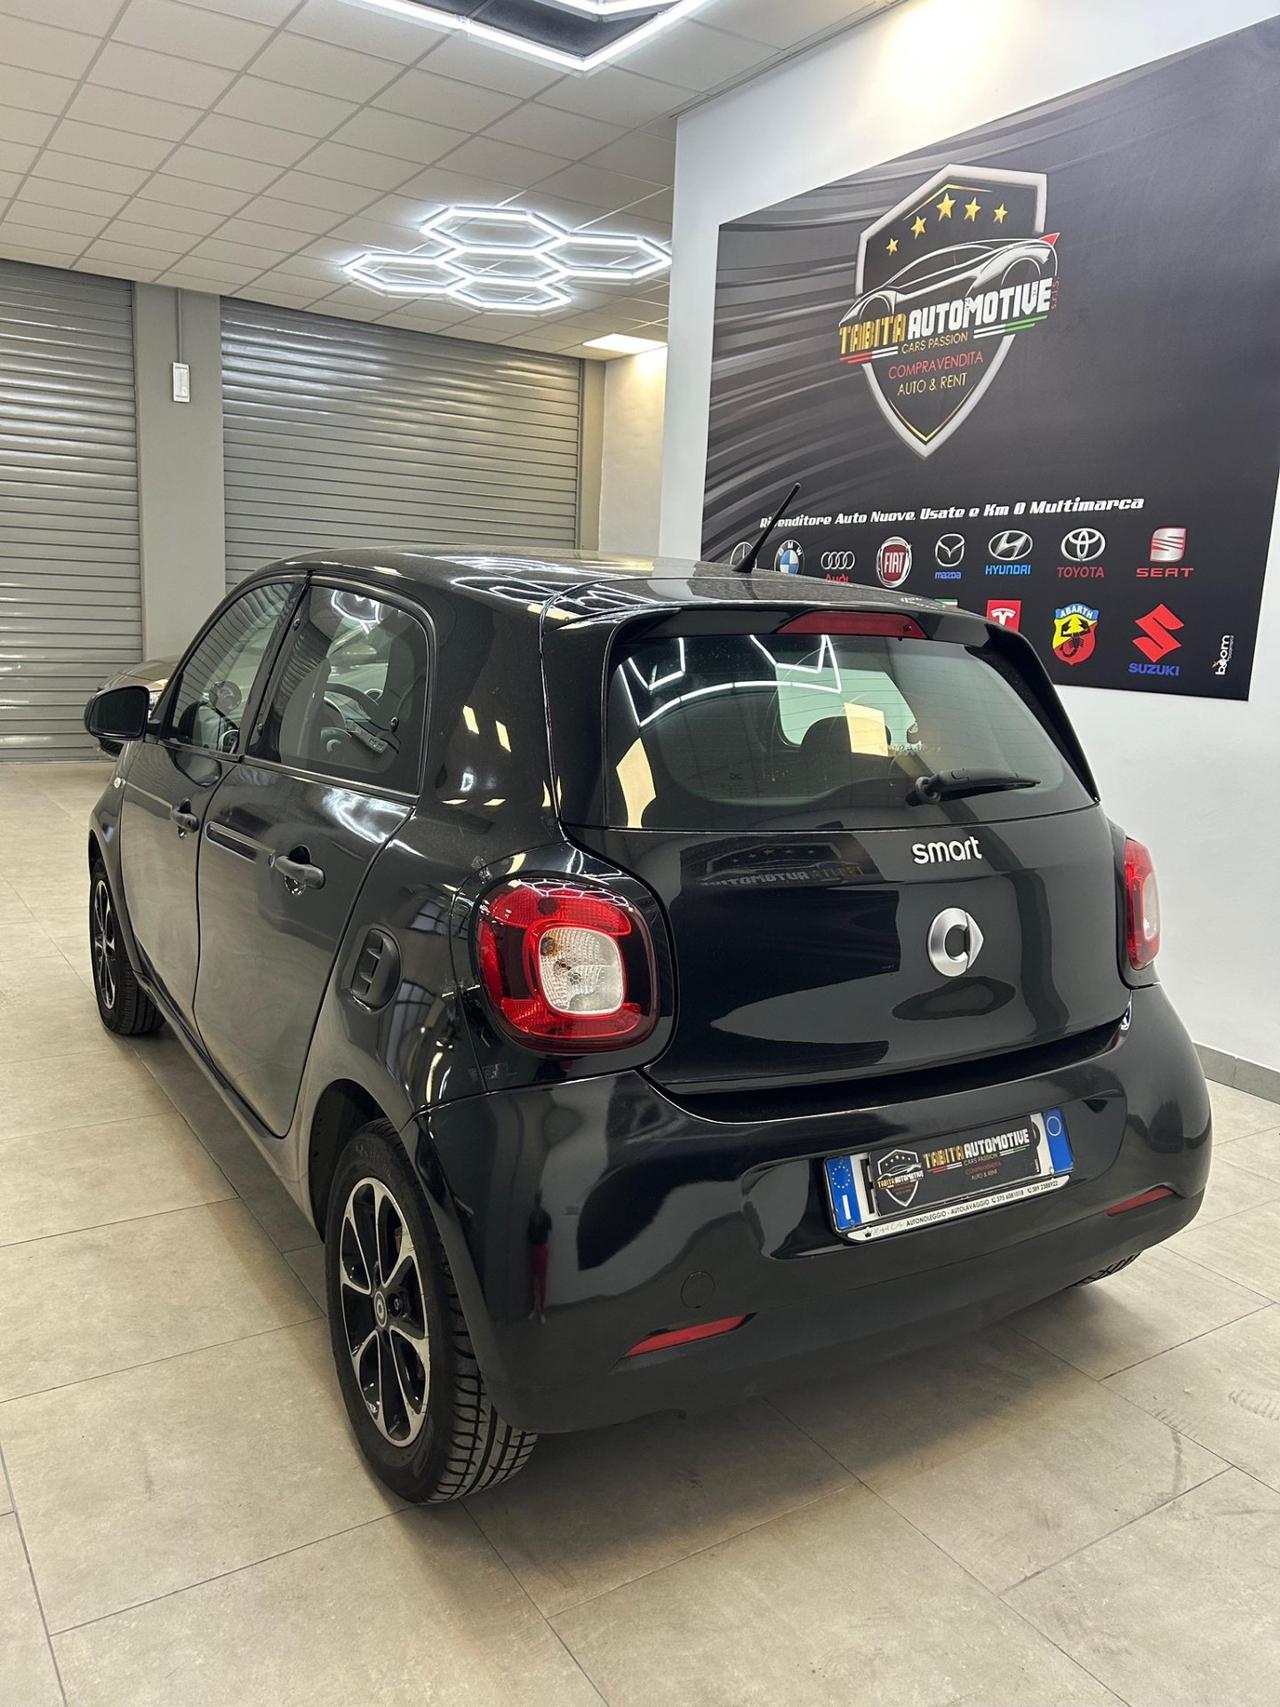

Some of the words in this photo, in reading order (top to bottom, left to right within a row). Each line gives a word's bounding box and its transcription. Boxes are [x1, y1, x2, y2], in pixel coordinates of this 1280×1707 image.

[839, 314, 907, 355] TABITA
[907, 278, 1053, 340] AUTOMOTIVE
[901, 341, 926, 354] CARS
[928, 331, 969, 349] PASSION
[888, 351, 984, 380] COMPRAVENDITA
[897, 380, 927, 396] AUTO
[929, 378, 937, 391] &
[940, 372, 968, 389] RENT
[759, 514, 831, 529] Rienditore
[834, 513, 867, 525] Auto
[920, 507, 965, 520] Usate
[968, 507, 980, 518] e
[983, 503, 1010, 517] Km
[1029, 497, 1145, 515] Multimarca
[884, 552, 905, 573] FIAT
[985, 565, 1031, 576] HYUNDAI
[1057, 566, 1105, 578] TOYOTA
[1136, 567, 1194, 577] SEAT
[1060, 604, 1094, 620] ABARTH
[1128, 663, 1180, 676] SUZUKI
[911, 836, 982, 865] smart
[963, 1128, 1030, 1159] AUTOMOTIVE
